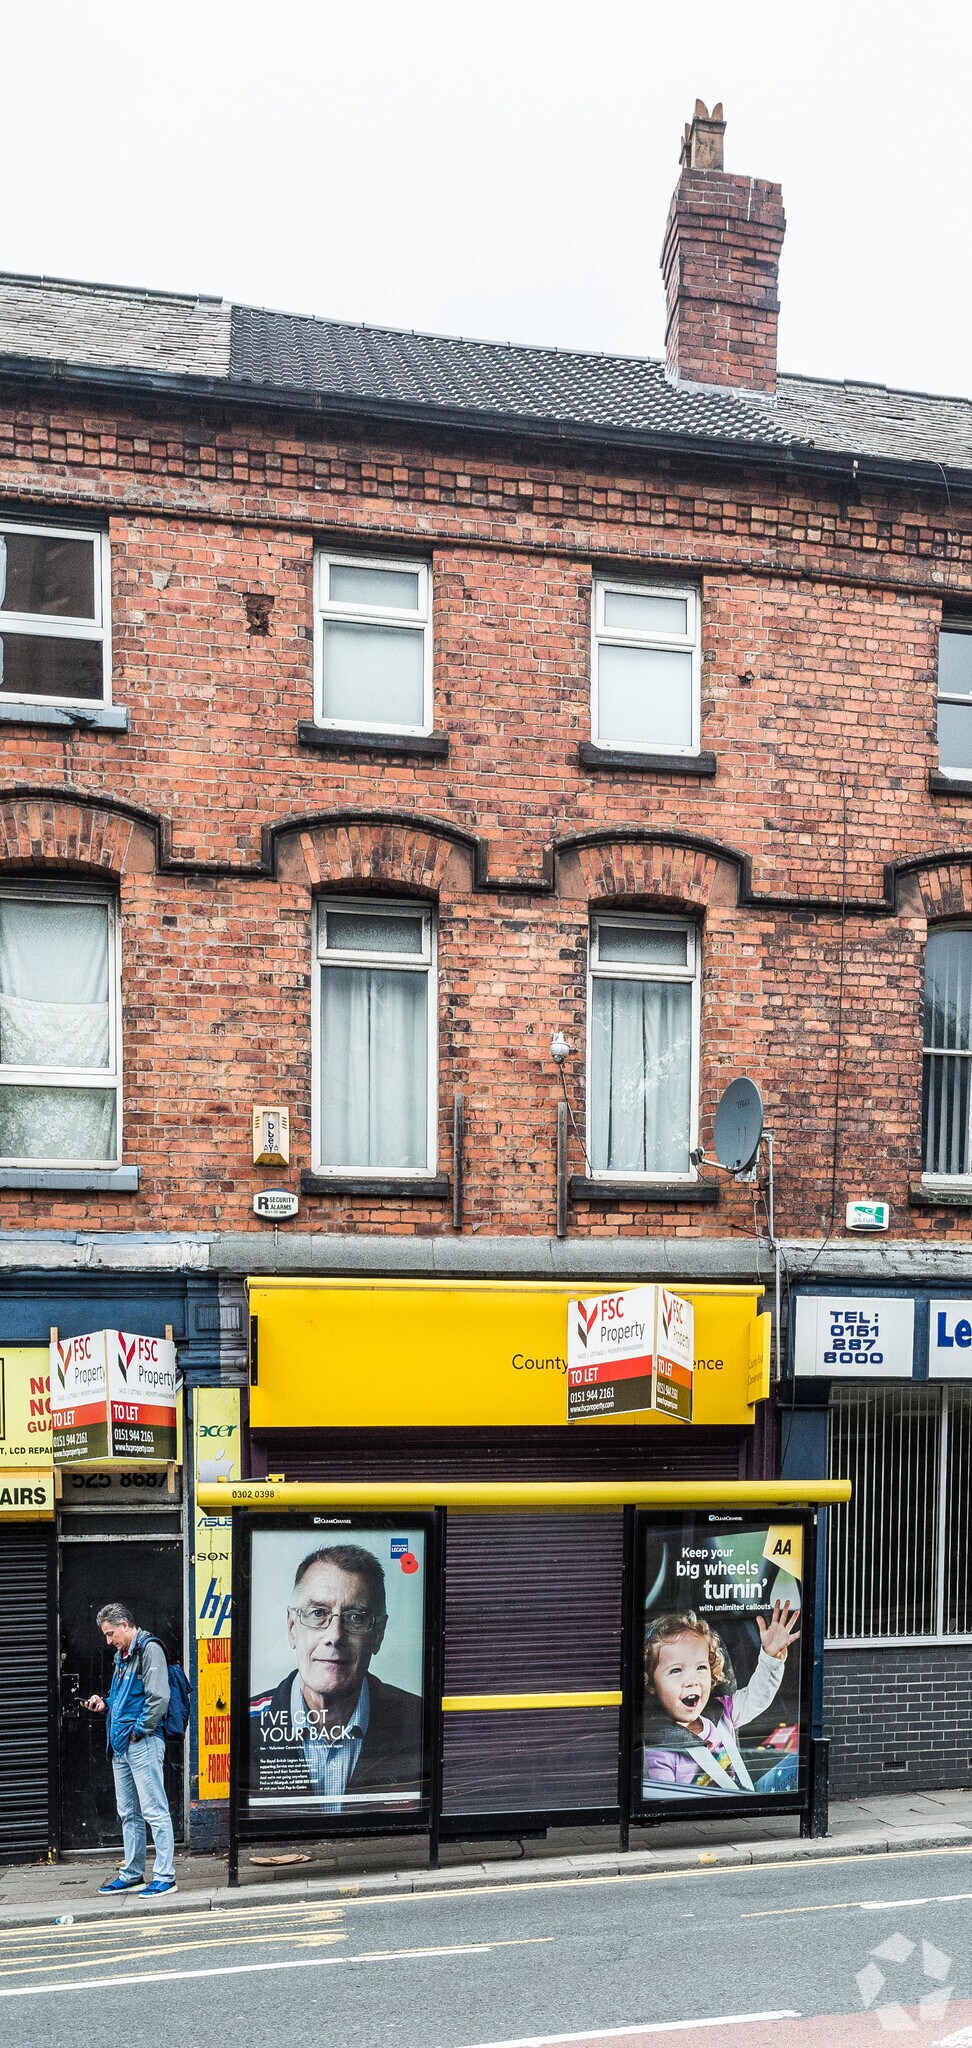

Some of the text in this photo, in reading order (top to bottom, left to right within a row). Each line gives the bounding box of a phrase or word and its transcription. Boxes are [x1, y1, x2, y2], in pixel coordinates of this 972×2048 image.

[258, 1197, 269, 1210] R
[601, 1297, 625, 1321] FSC
[673, 1300, 683, 1325] FSC
[830, 1311, 879, 1323] TEL:
[601, 1322, 645, 1344] Property
[830, 1325, 879, 1337] 0151
[937, 1312, 972, 1348] Le
[74, 1337, 91, 1361] FSC
[139, 1338, 158, 1362] FSC
[832, 1338, 876, 1351] 287
[512, 1354, 568, 1374] County
[693, 1359, 724, 1370] nce
[824, 1352, 884, 1364] 8000
[571, 1367, 599, 1384] TO LET
[658, 1359, 673, 1377] TO LET
[139, 1365, 175, 1391] Property
[570, 1387, 615, 1403] 0151 944 2161
[113, 1404, 139, 1421] TO LET
[570, 1401, 615, 1413] www.fscproperty.com
[53, 1410, 75, 1427] TO LET
[114, 1428, 154, 1443] 0151 944 2161
[196, 1425, 238, 1437] acer
[53, 1432, 88, 1447] 0151 944 2161
[9, 1447, 26, 1455] LCD
[73, 1473, 112, 1488] 525
[0, 1487, 46, 1505] AIRS
[232, 1491, 275, 1499] 0302 0398
[682, 1547, 734, 1559] Keep your
[772, 1539, 792, 1555] AA
[197, 1552, 232, 1561] SON
[676, 1560, 759, 1579] big wheels
[703, 1578, 768, 1599] turnin'
[199, 1577, 231, 1636] hp
[699, 1604, 714, 1612] with
[746, 1603, 772, 1611] callouts
[260, 1709, 328, 1726] I'VE GOT
[260, 1726, 355, 1742] YOUR BACK.
